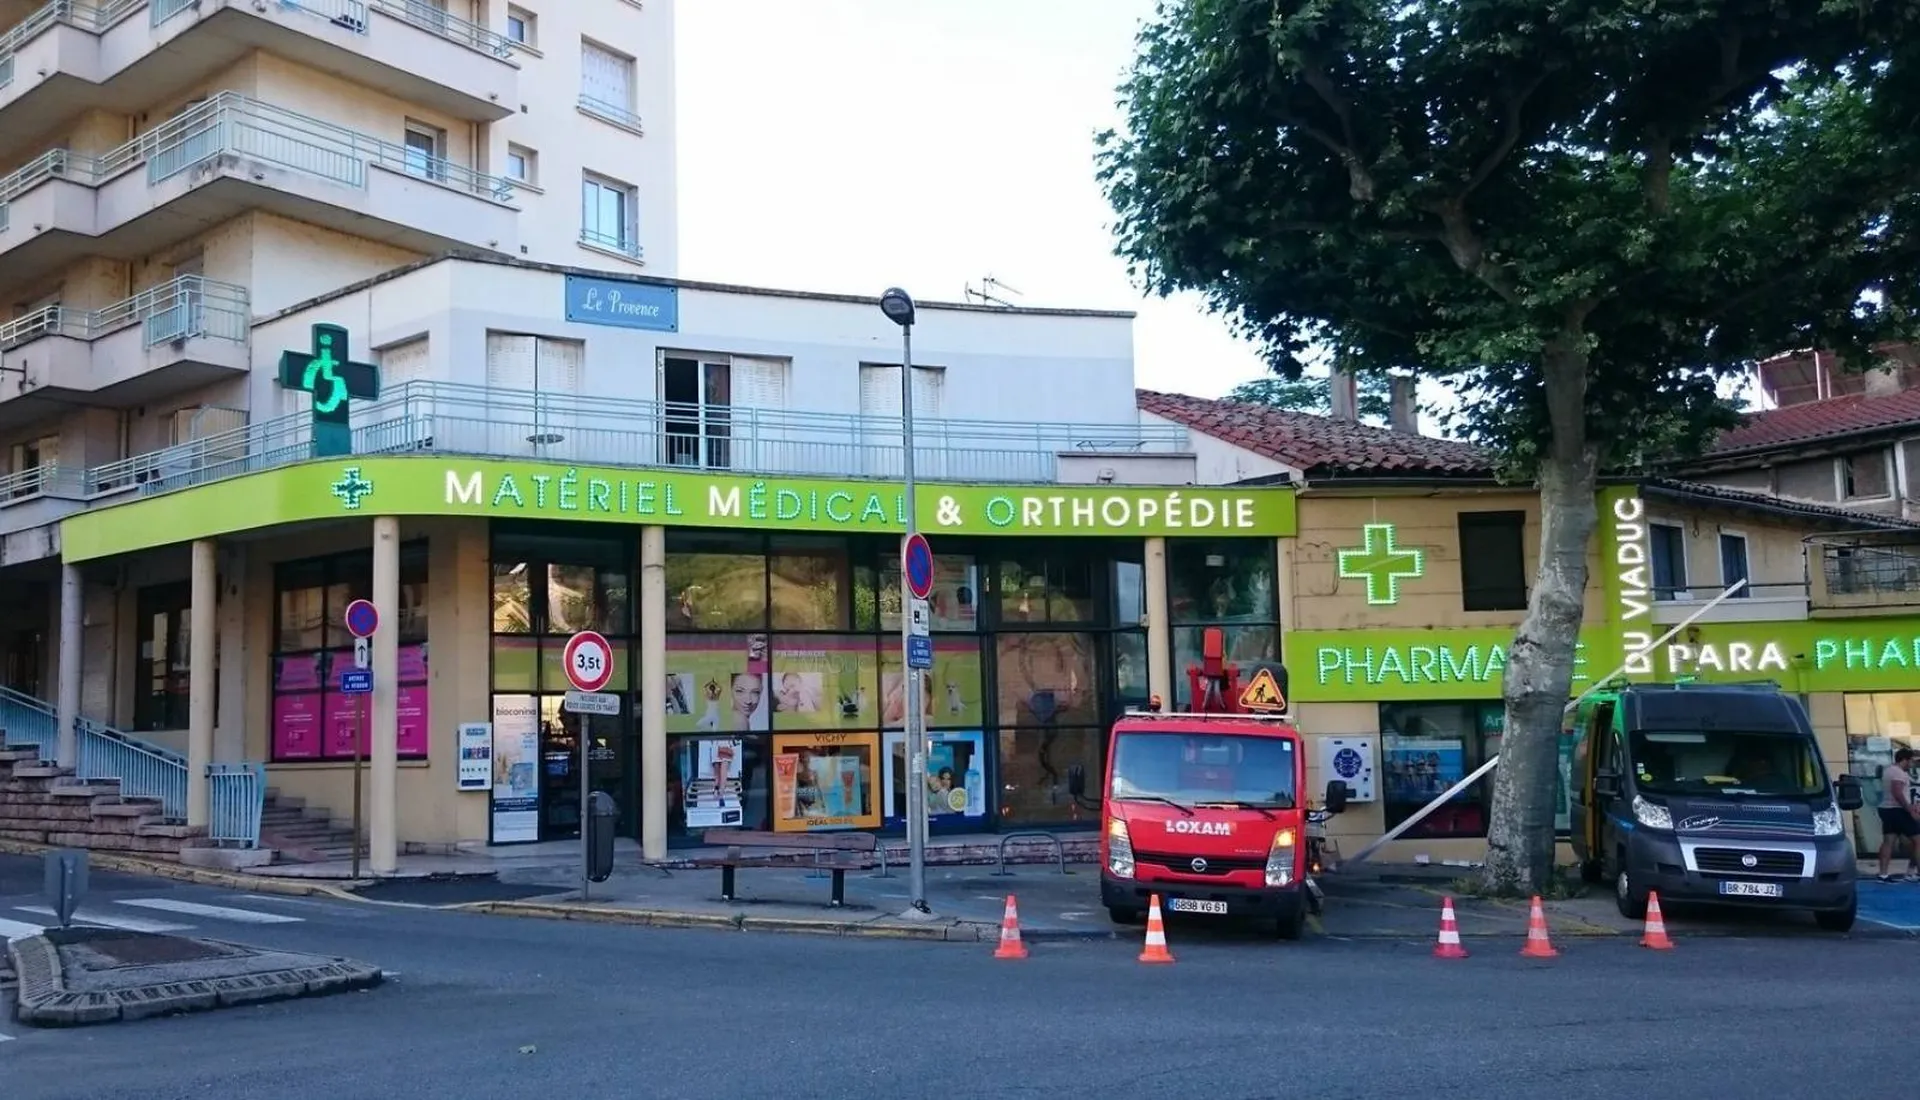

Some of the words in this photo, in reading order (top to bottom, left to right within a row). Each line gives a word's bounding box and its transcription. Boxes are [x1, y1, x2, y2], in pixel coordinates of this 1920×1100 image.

[581, 287, 603, 312] Le
[607, 289, 660, 317] Provence
[445, 468, 683, 516] MATÉRIEL
[936, 496, 963, 527] &
[985, 492, 1256, 528] ORTHOPÉDIE
[1614, 497, 1650, 620] VIADUC
[577, 654, 601, 671] 3,5t
[1317, 644, 1589, 684] PHARMAE
[1668, 642, 1788, 674] PARA
[1815, 638, 1920, 671] PHA
[814, 733, 848, 742] VICHY
[1166, 819, 1232, 836] LOXAM
